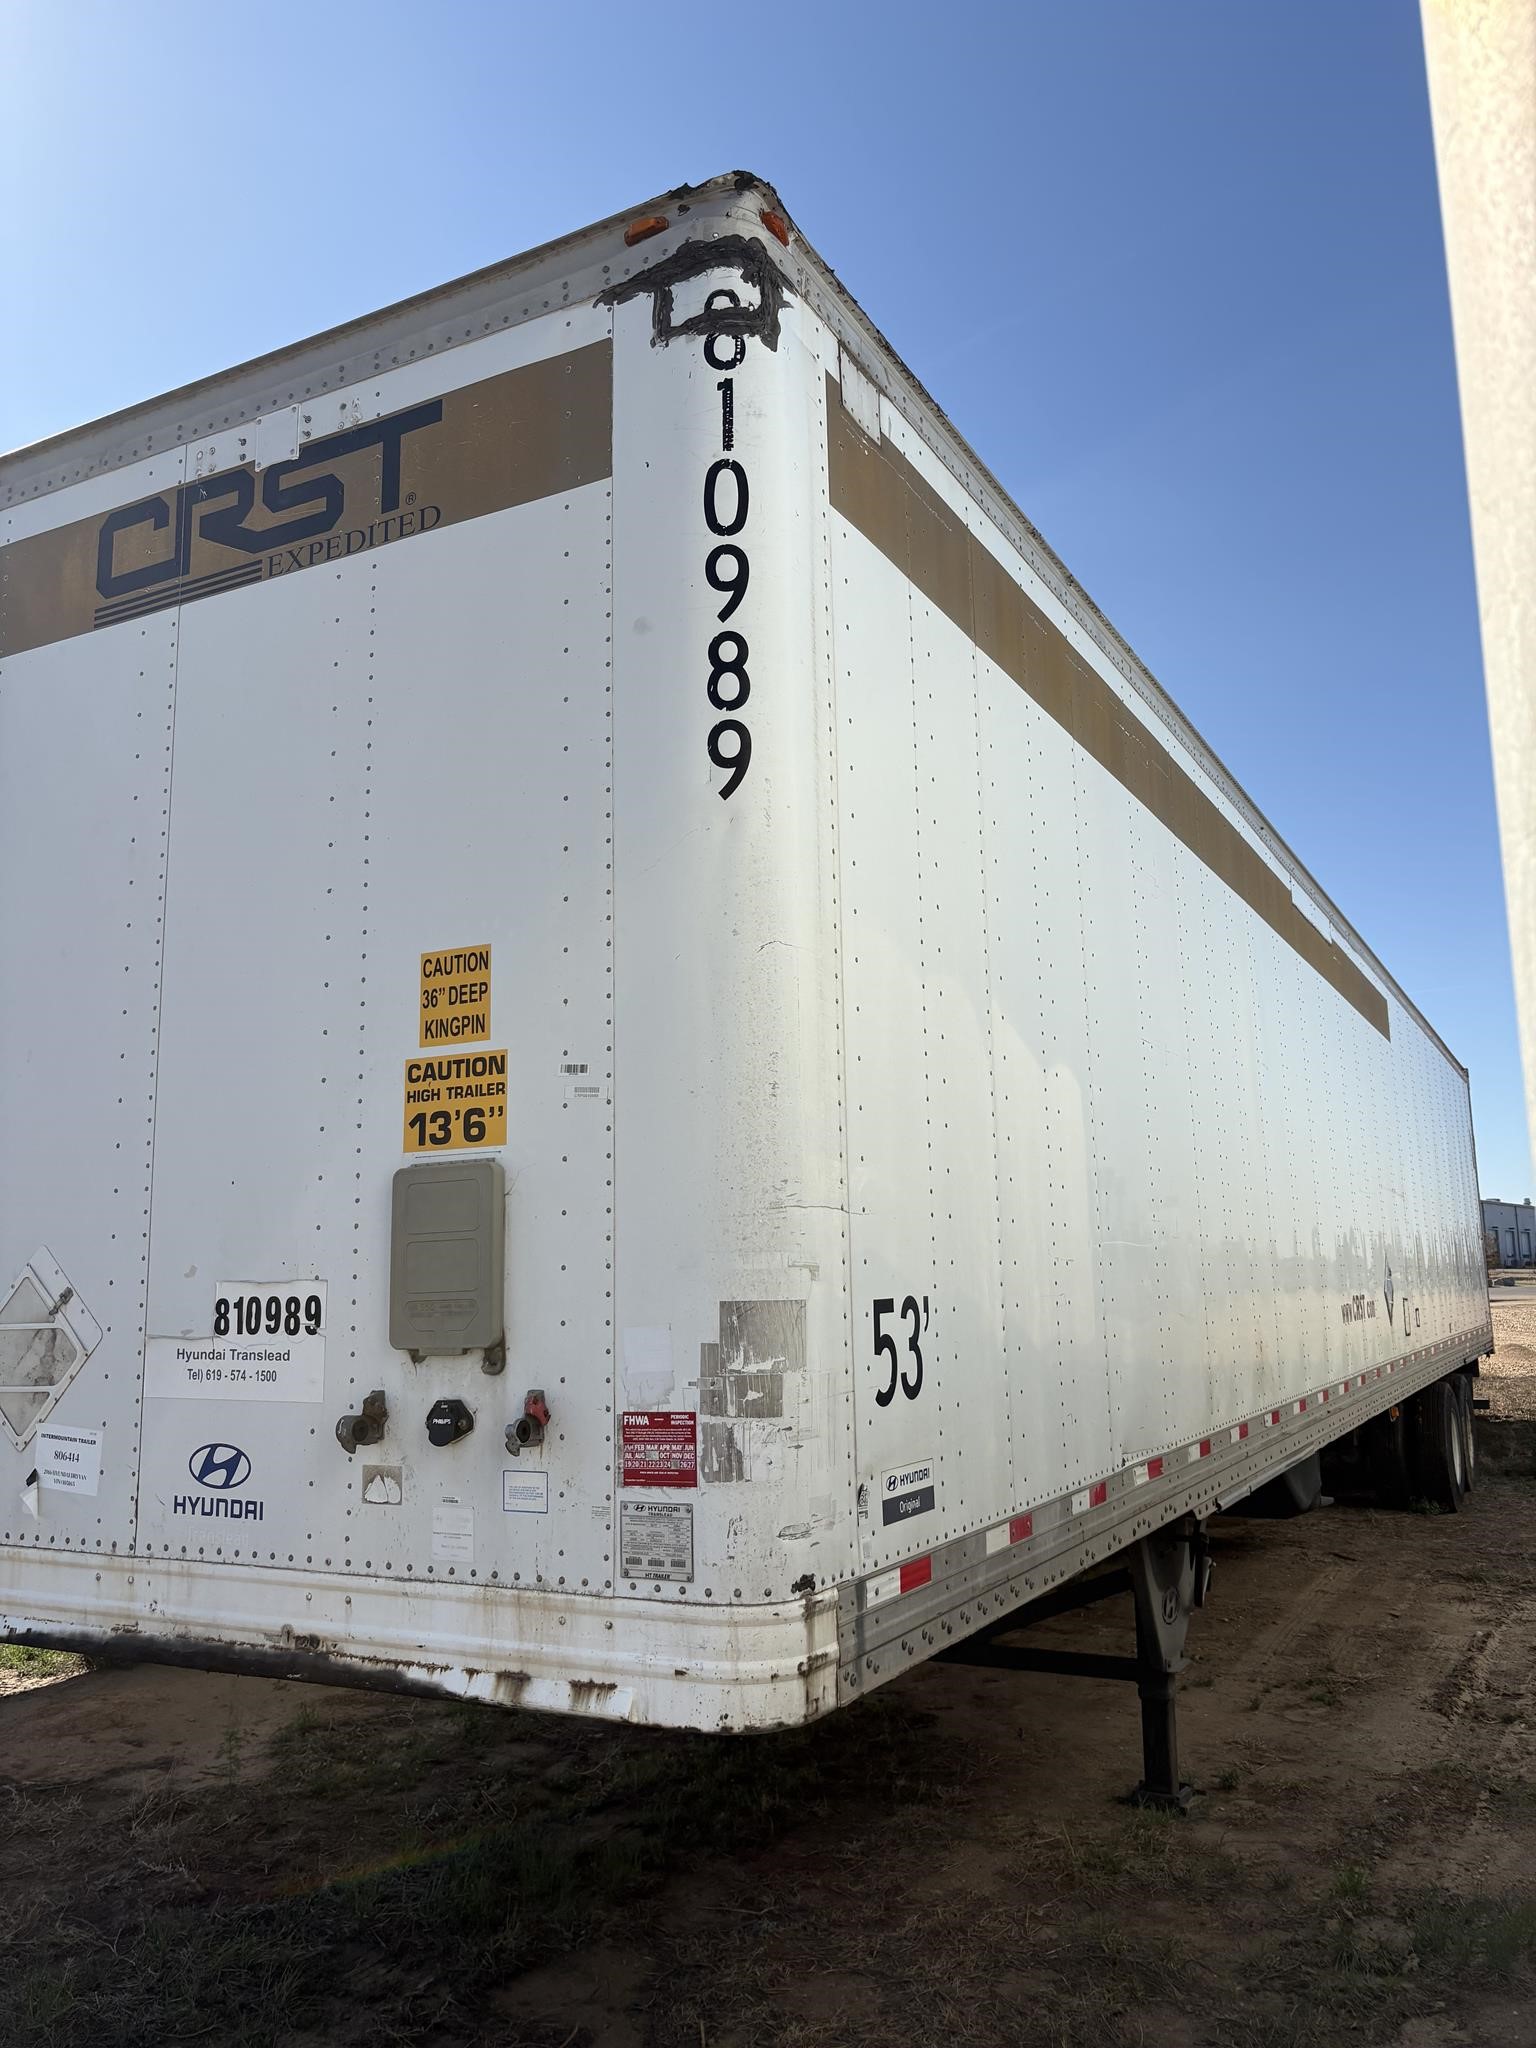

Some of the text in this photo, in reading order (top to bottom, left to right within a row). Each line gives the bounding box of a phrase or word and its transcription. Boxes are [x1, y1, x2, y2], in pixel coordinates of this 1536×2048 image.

[96, 400, 443, 599] CRST
[268, 504, 442, 577] EXPEDITED
[422, 950, 489, 978] CAUTION
[449, 981, 488, 1006] DEEP
[424, 1013, 486, 1040] KINGPIN
[407, 1055, 506, 1083] CAUTION
[407, 1082, 506, 1104] HIGH TRAILER
[214, 1295, 322, 1336] 810989
[176, 1348, 290, 1362] Hyundai Translead
[873, 1295, 929, 1408] 53'
[187, 1368, 203, 1383] Tel)
[205, 1369, 222, 1381] 619
[230, 1369, 246, 1381] 574
[255, 1370, 277, 1382] 1500
[623, 1414, 650, 1426] FHWA
[54, 1450, 80, 1463] 806414
[899, 1467, 930, 1486] HYUNDAI
[173, 1495, 264, 1521] HYUNDAI
[647, 1505, 681, 1513] HYUNDAI
[900, 1496, 921, 1513] Original
